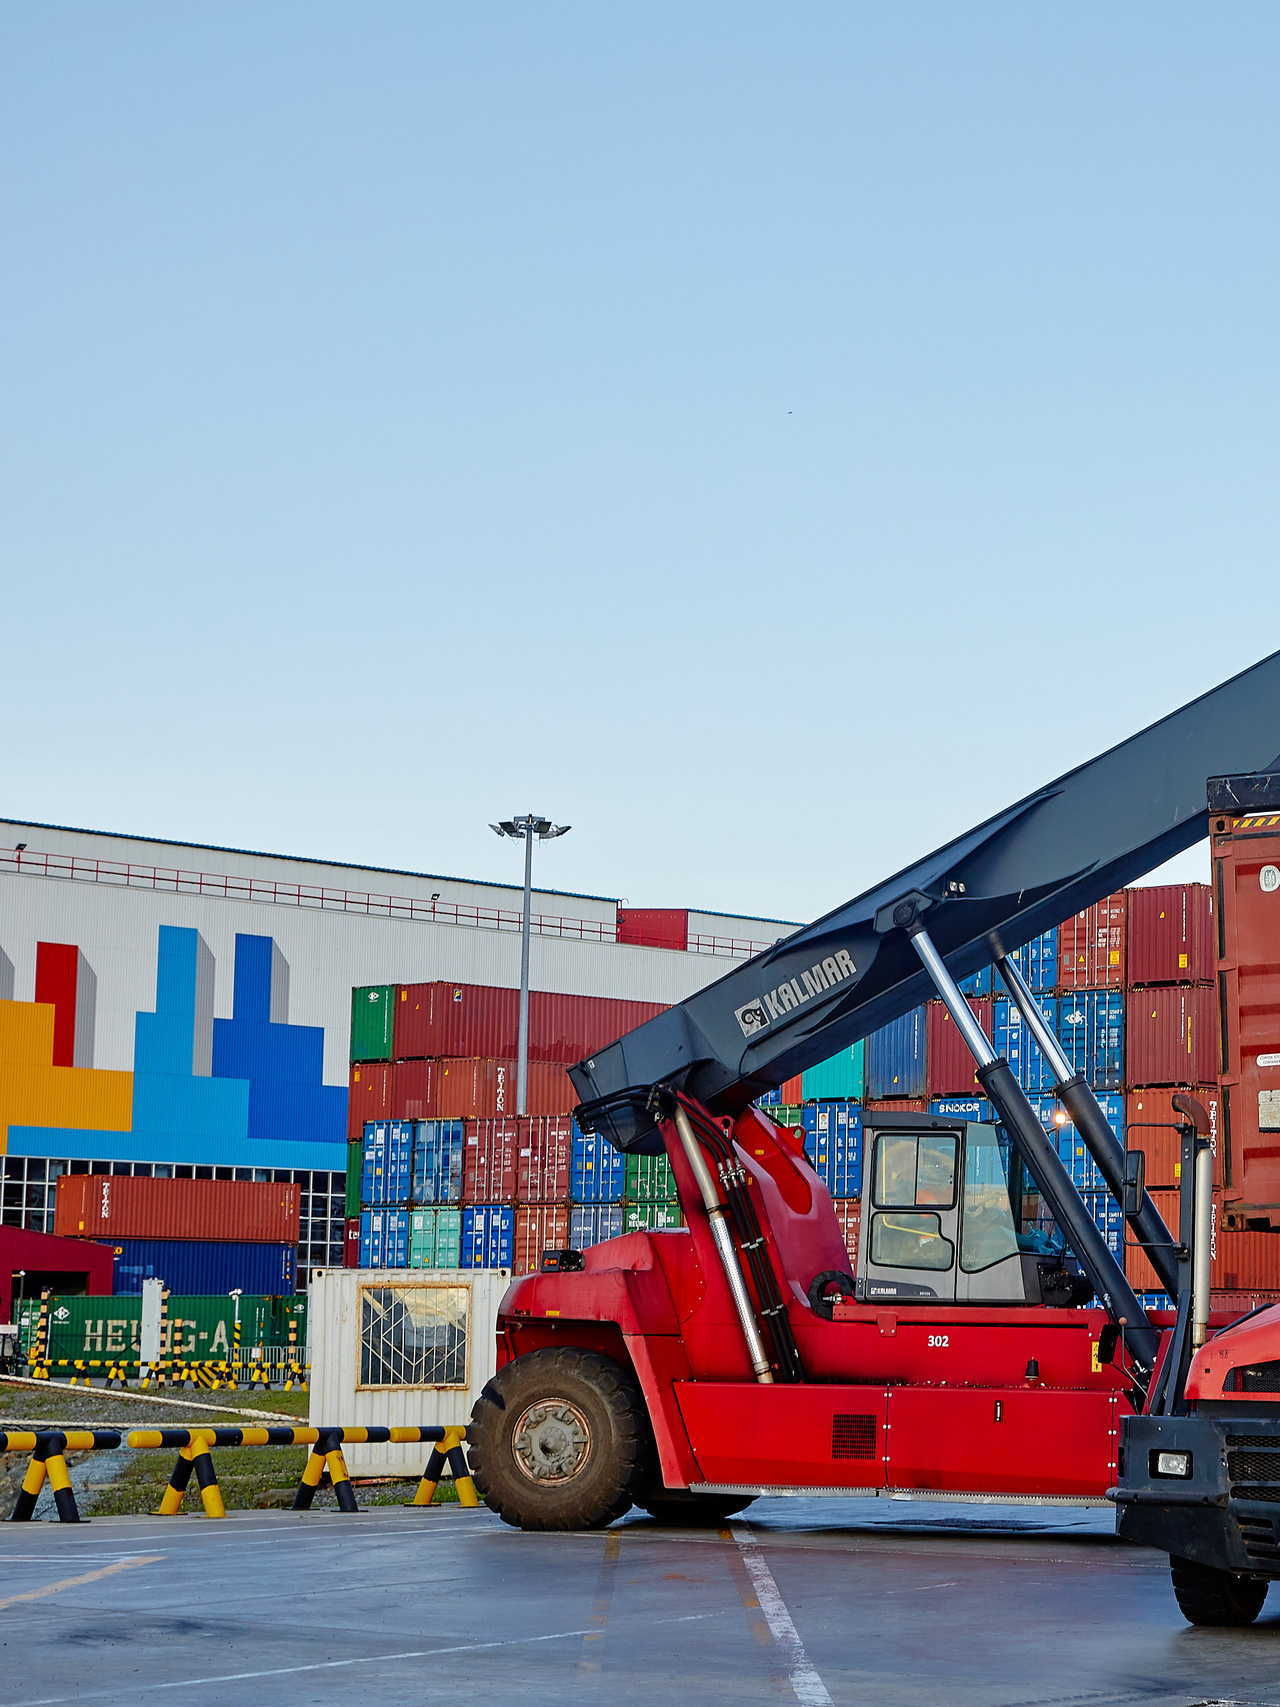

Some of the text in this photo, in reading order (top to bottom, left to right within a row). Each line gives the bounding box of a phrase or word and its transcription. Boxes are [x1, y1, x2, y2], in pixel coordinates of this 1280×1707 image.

[763, 949, 857, 1020] KALMAR
[496, 1067, 505, 1112] TRITON
[102, 1182, 110, 1218] TRITON
[348, 1230, 359, 1240] te
[83, 1319, 229, 1353] HEG-A
[927, 1335, 949, 1347] 302
